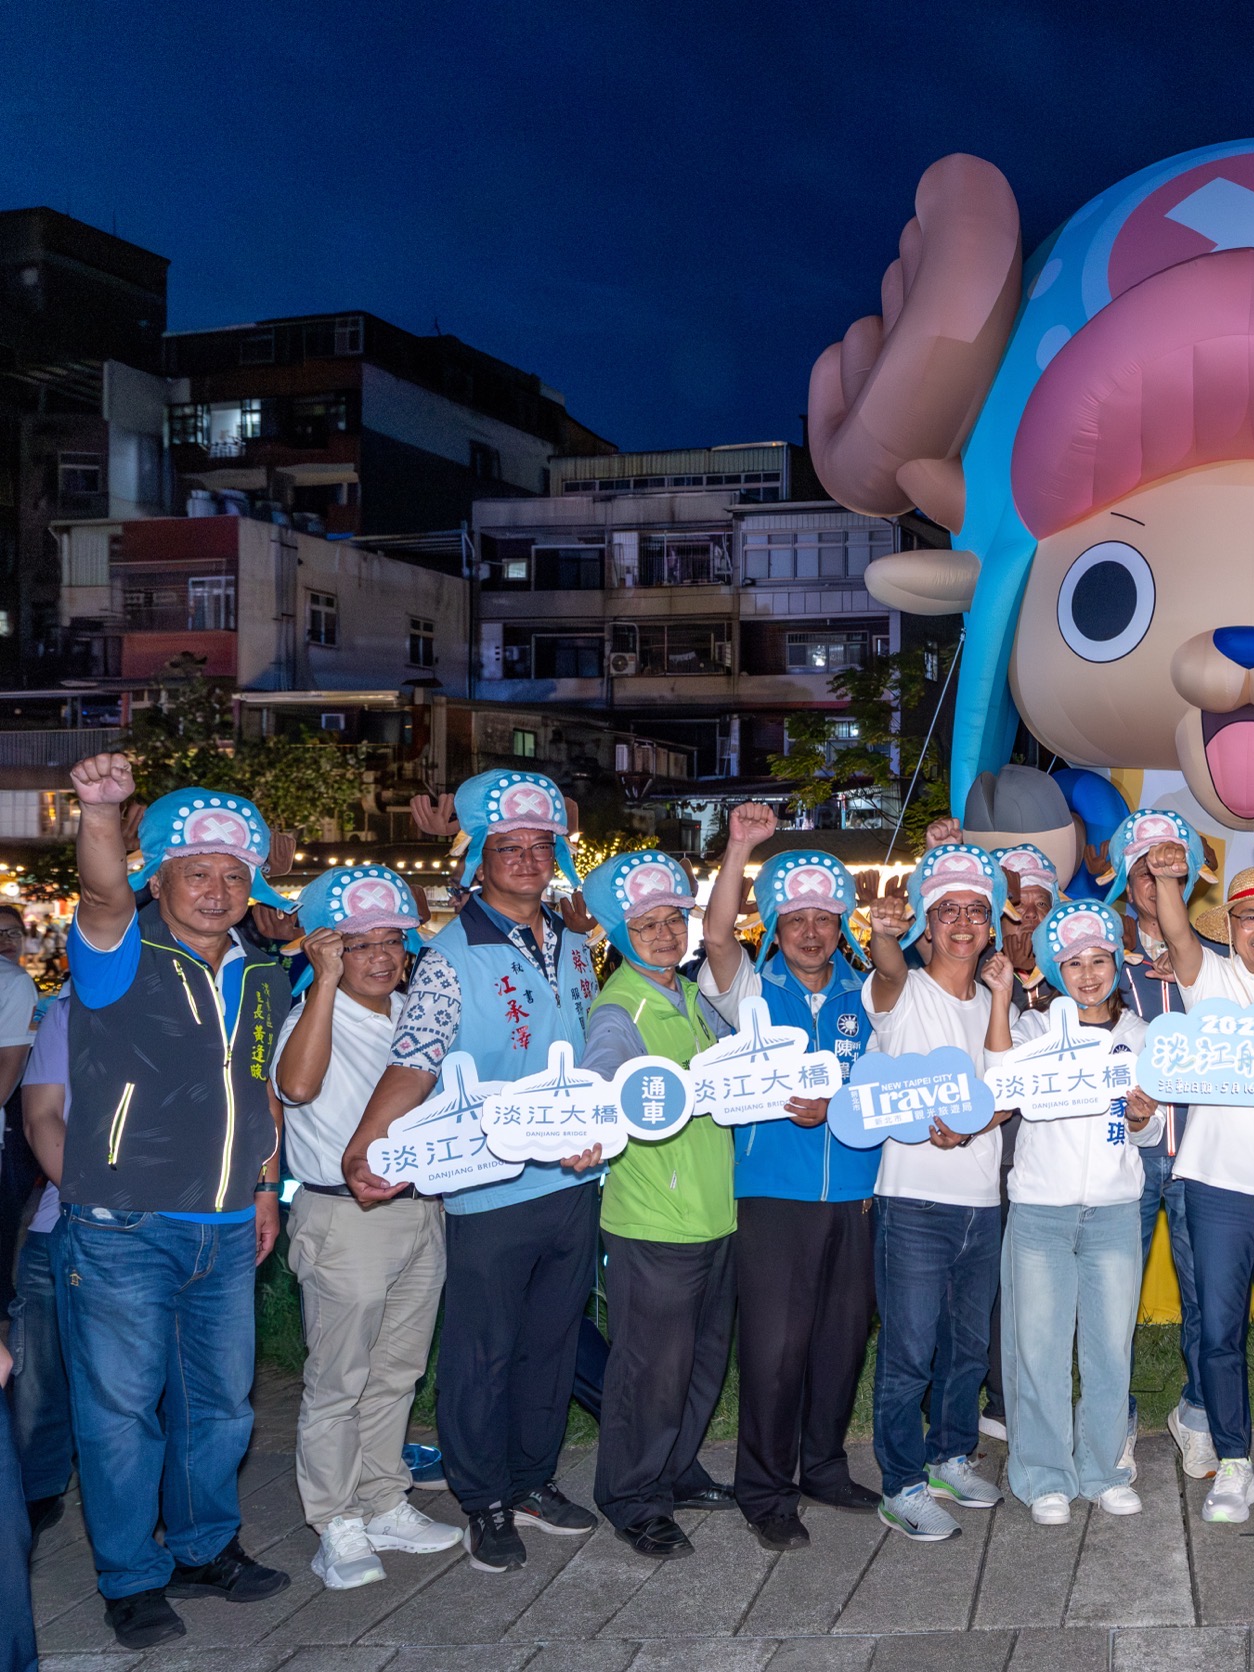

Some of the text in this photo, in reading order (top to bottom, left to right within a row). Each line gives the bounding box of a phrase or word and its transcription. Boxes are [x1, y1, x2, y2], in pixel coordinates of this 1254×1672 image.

[571, 949, 593, 1017] 蔡錦
[494, 975, 532, 1050] 江承澤
[641, 1075, 666, 1125] 通車
[695, 1062, 830, 1104] 淡江大橋
[848, 1073, 971, 1118] Travel
[881, 1073, 953, 1092] NEW TAIPEI CITY
[995, 1064, 1132, 1100] 淡江大橋
[493, 1104, 618, 1126] 淡江大橋
[724, 1100, 790, 1114] DANJIANG BRID
[1032, 1097, 1099, 1109] DANJIANG BRIDGE
[428, 1160, 505, 1181] DANJIANG BRIDG
